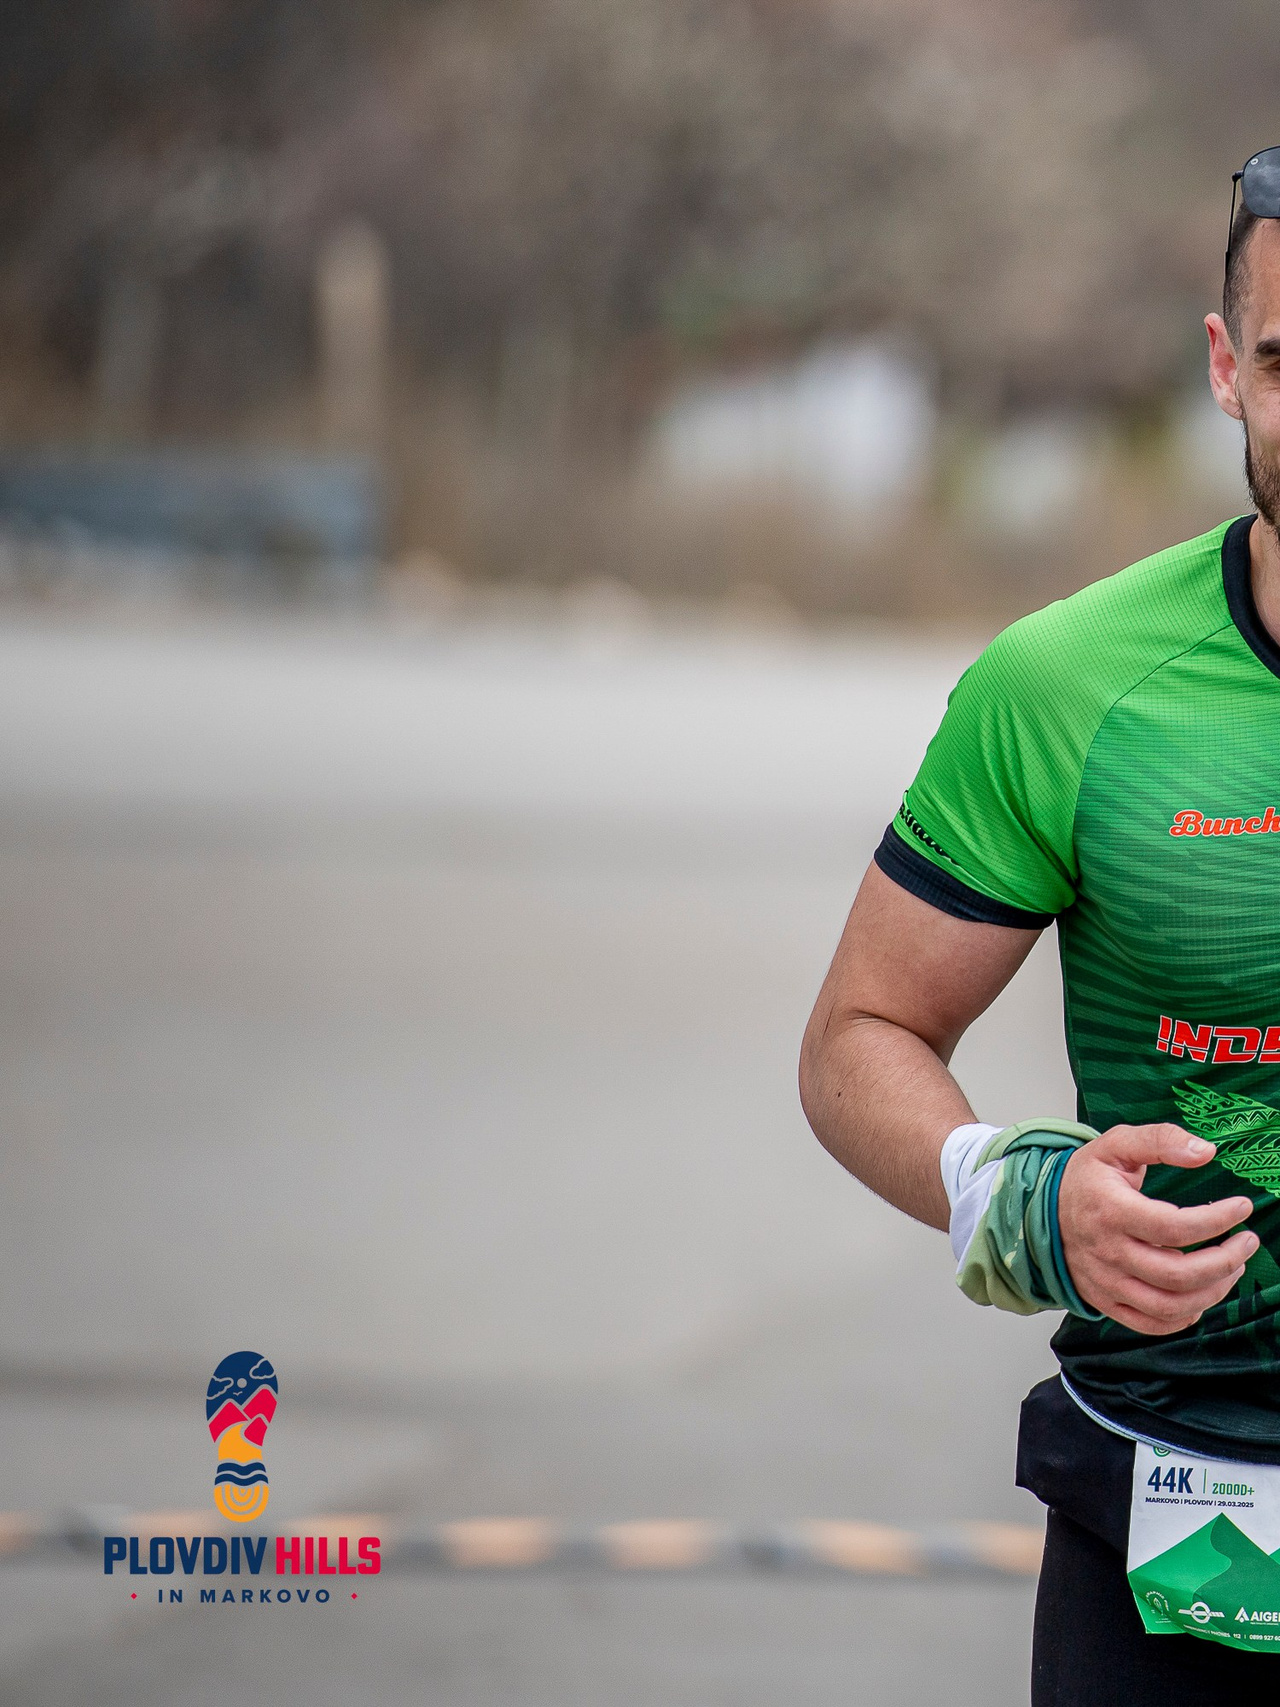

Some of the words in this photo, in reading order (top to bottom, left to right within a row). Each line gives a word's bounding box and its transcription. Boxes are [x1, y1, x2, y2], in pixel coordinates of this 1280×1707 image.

[1147, 1466, 1194, 1494] 44K
[1145, 1496, 1180, 1505] MARKOVO
[1183, 1499, 1214, 1507] PLOVDIV
[1217, 1500, 1255, 1508] 29.03.2025
